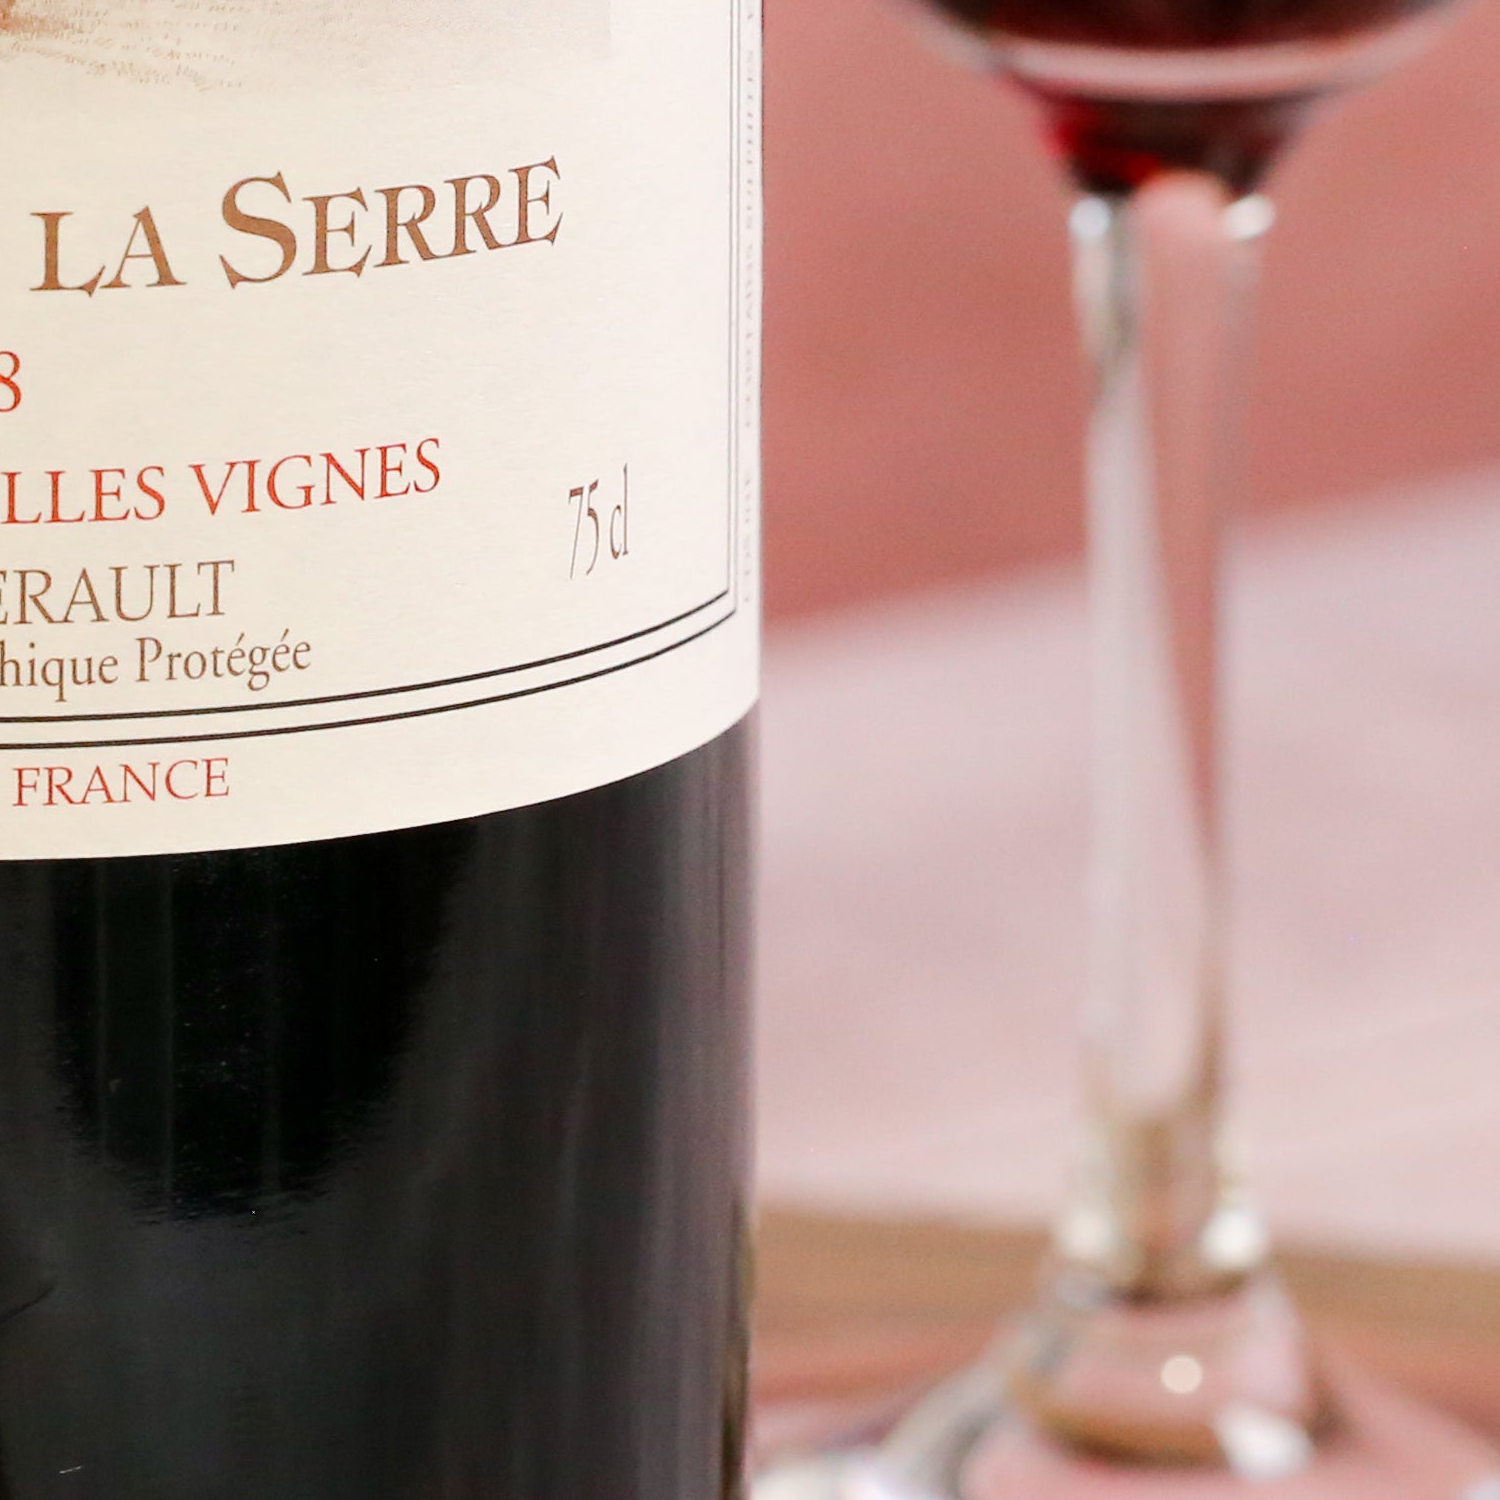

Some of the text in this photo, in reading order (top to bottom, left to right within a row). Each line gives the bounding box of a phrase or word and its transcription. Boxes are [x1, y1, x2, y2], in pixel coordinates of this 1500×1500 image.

[29, 205, 187, 298] LA
[218, 155, 563, 290] SERRE
[188, 437, 441, 516] VIGNES
[568, 462, 629, 580] 75 cl
[135, 628, 311, 691] Protégée
[12, 757, 229, 807] FRANCE
